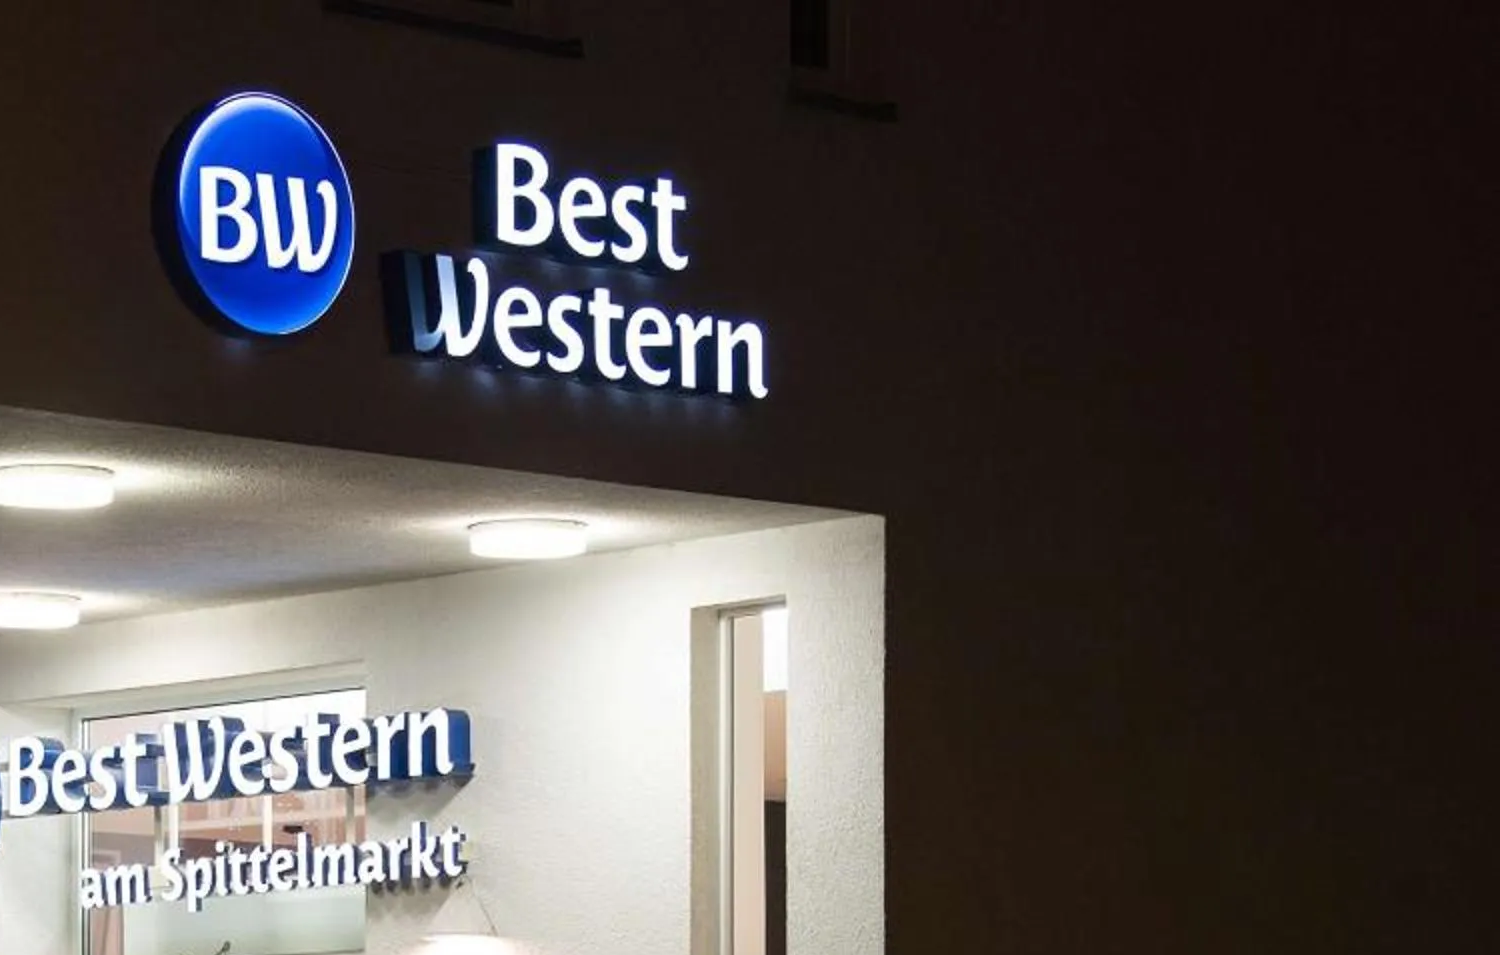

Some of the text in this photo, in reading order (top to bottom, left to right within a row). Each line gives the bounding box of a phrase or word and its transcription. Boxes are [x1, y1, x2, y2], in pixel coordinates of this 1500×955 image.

[200, 165, 338, 272] BW
[496, 143, 689, 271] Best
[404, 251, 769, 399] Western
[8, 706, 455, 818] Best Western
[79, 820, 468, 913] am Spittelmarkt
